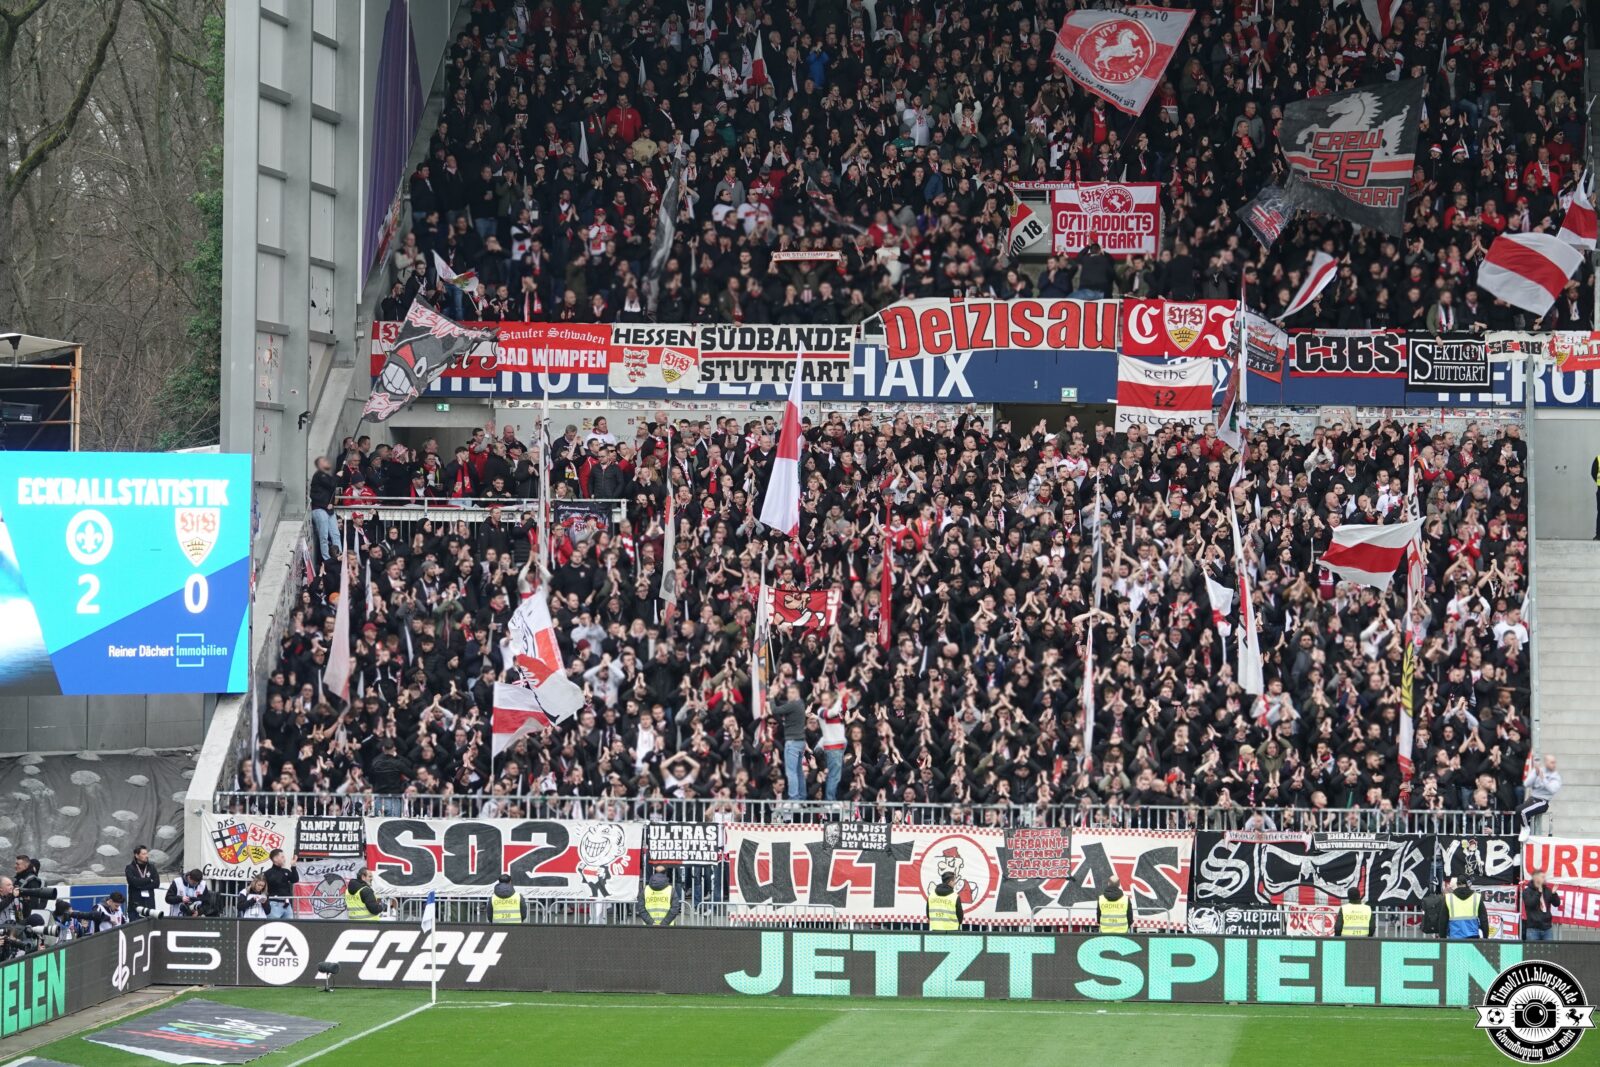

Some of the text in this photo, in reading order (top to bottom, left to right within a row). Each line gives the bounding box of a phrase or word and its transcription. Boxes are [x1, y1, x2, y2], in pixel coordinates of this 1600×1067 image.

[1310, 150, 1373, 187] 36
[1059, 213, 1152, 231] 0711 ADDICTS
[547, 327, 605, 344] Schwaben
[614, 328, 696, 347] HESSEN
[701, 324, 850, 352] SÜDBANDE
[496, 347, 529, 366] BAD
[532, 347, 607, 368] WIMPFEN
[701, 360, 849, 382] STUTTGART
[1153, 389, 1177, 408] 12
[17, 477, 230, 506] ECKBALLSTATISTIK
[75, 573, 209, 615] 2 0
[109, 645, 137, 658] Reiner
[176, 644, 228, 656] Immobilien
[300, 820, 337, 831] KAMPF
[650, 825, 717, 840] ULTRAS
[842, 823, 887, 833] DU BIST
[300, 831, 359, 842] EINSATZ FÜR
[842, 832, 887, 842] IMMER
[1014, 828, 1061, 838] JEDER
[1327, 832, 1376, 840] EHRE ALLEN
[650, 840, 717, 851] BEDEUTET
[862, 841, 888, 850] UNS!
[1007, 836, 1069, 849] VERBANNTE
[649, 850, 718, 861] WIDERSTAND
[1013, 849, 1064, 858] KEHRT
[304, 862, 356, 876] Leintal
[259, 936, 298, 956] EA
[257, 957, 299, 968] SPORTS
[724, 931, 1523, 1006] JETZT SPIELEN
